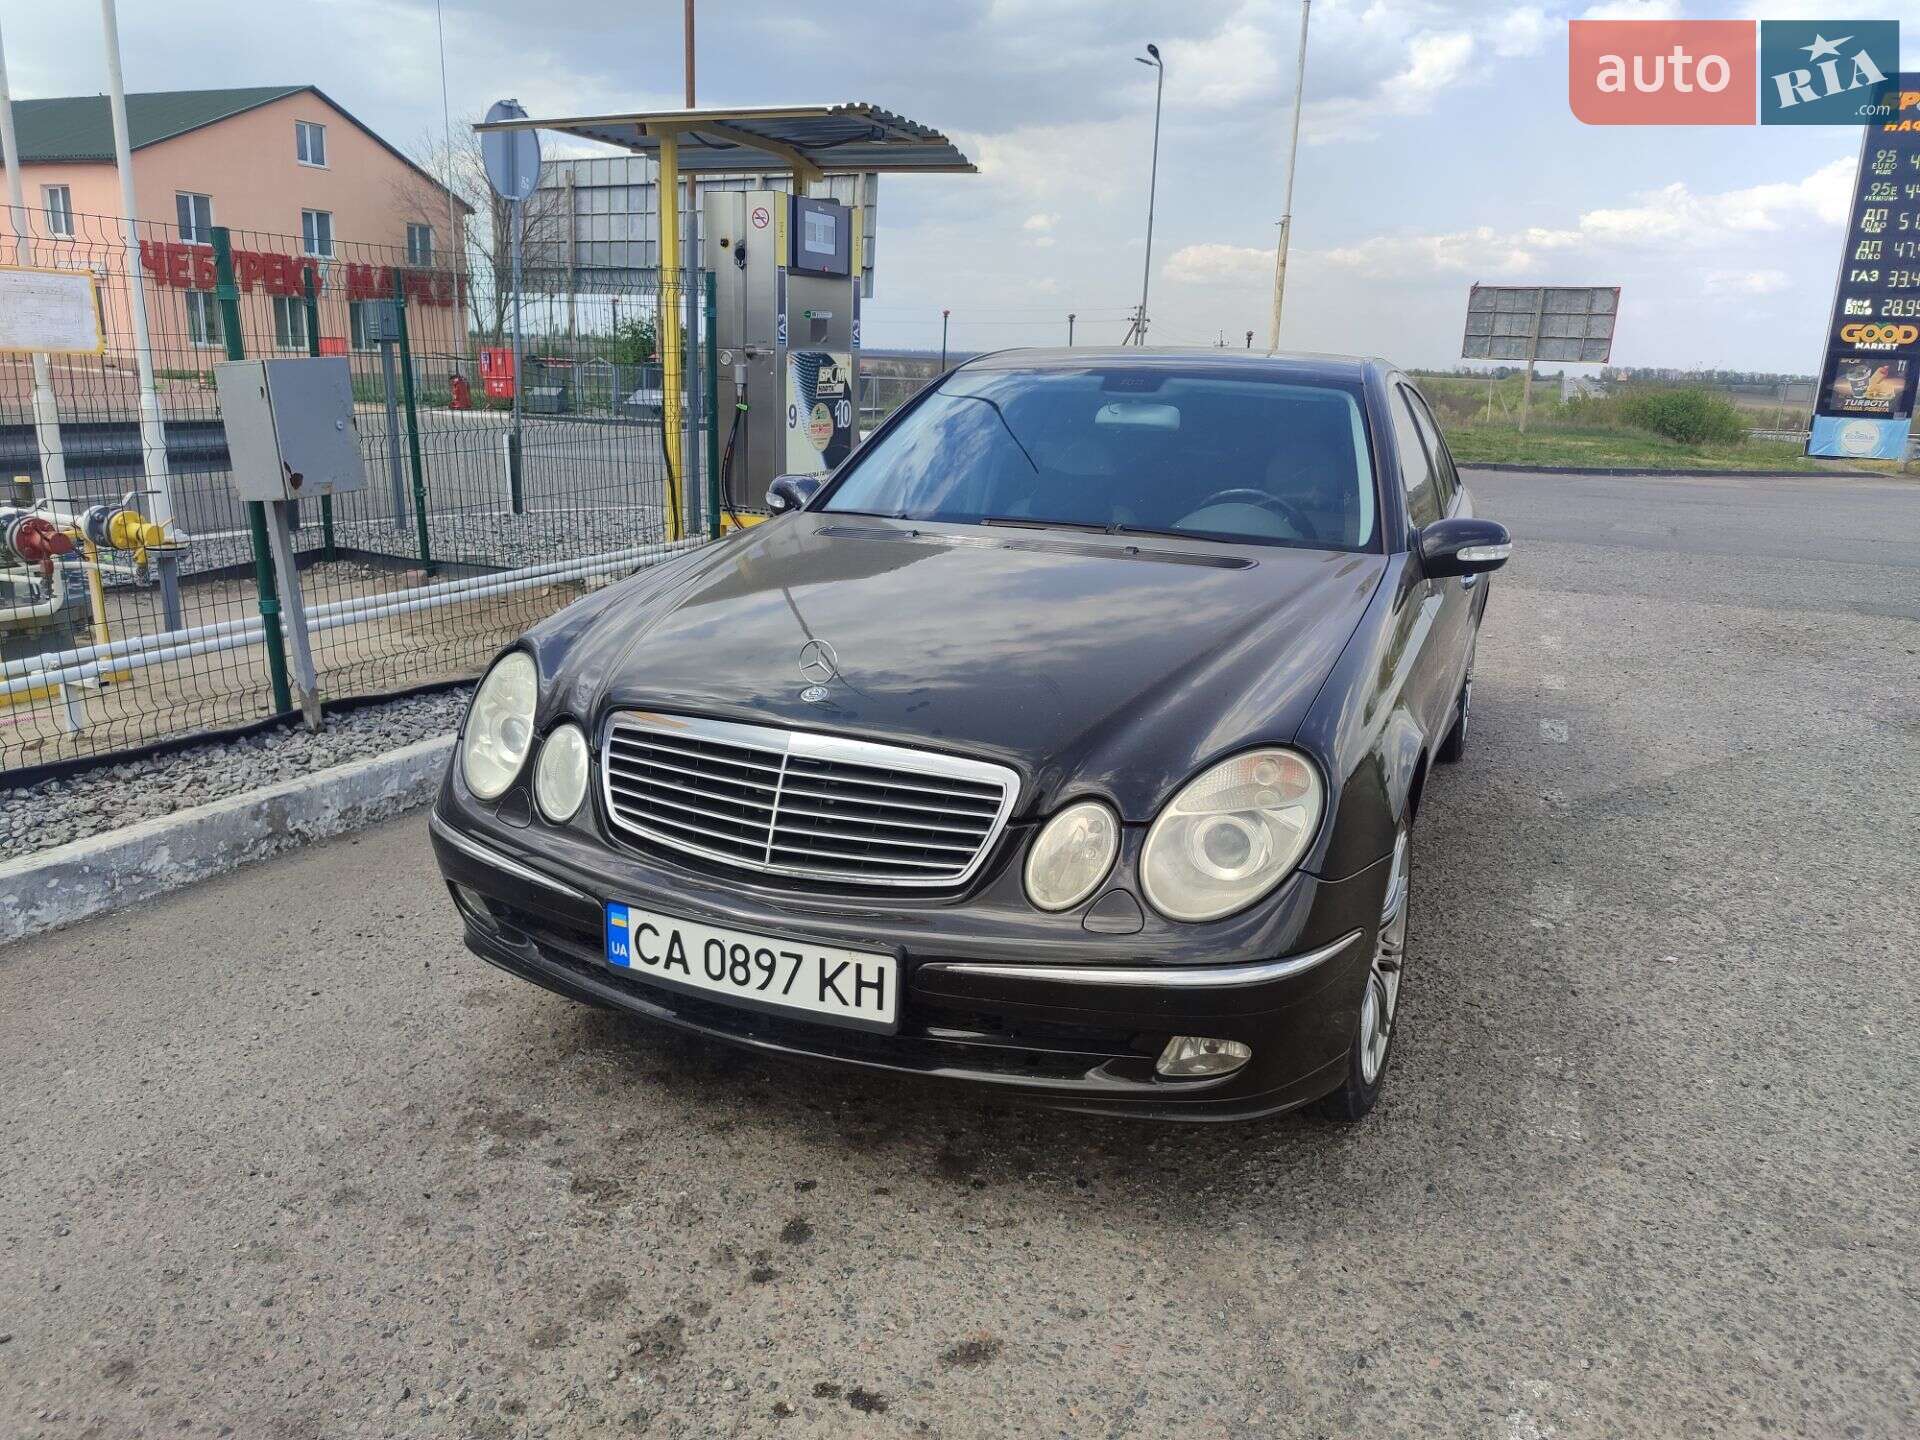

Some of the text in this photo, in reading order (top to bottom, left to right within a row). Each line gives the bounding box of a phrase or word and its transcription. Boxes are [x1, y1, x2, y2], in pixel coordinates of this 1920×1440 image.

[1876, 149, 1897, 163] 95
[1872, 162, 1898, 170] EURO
[1850, 269, 1880, 282] ГАЗ
[1841, 323, 1918, 344] GOOD
[1854, 342, 1899, 350] MARKET
[788, 399, 852, 429] 9 10
[611, 940, 628, 958] UA
[704, 938, 803, 996] 0897
